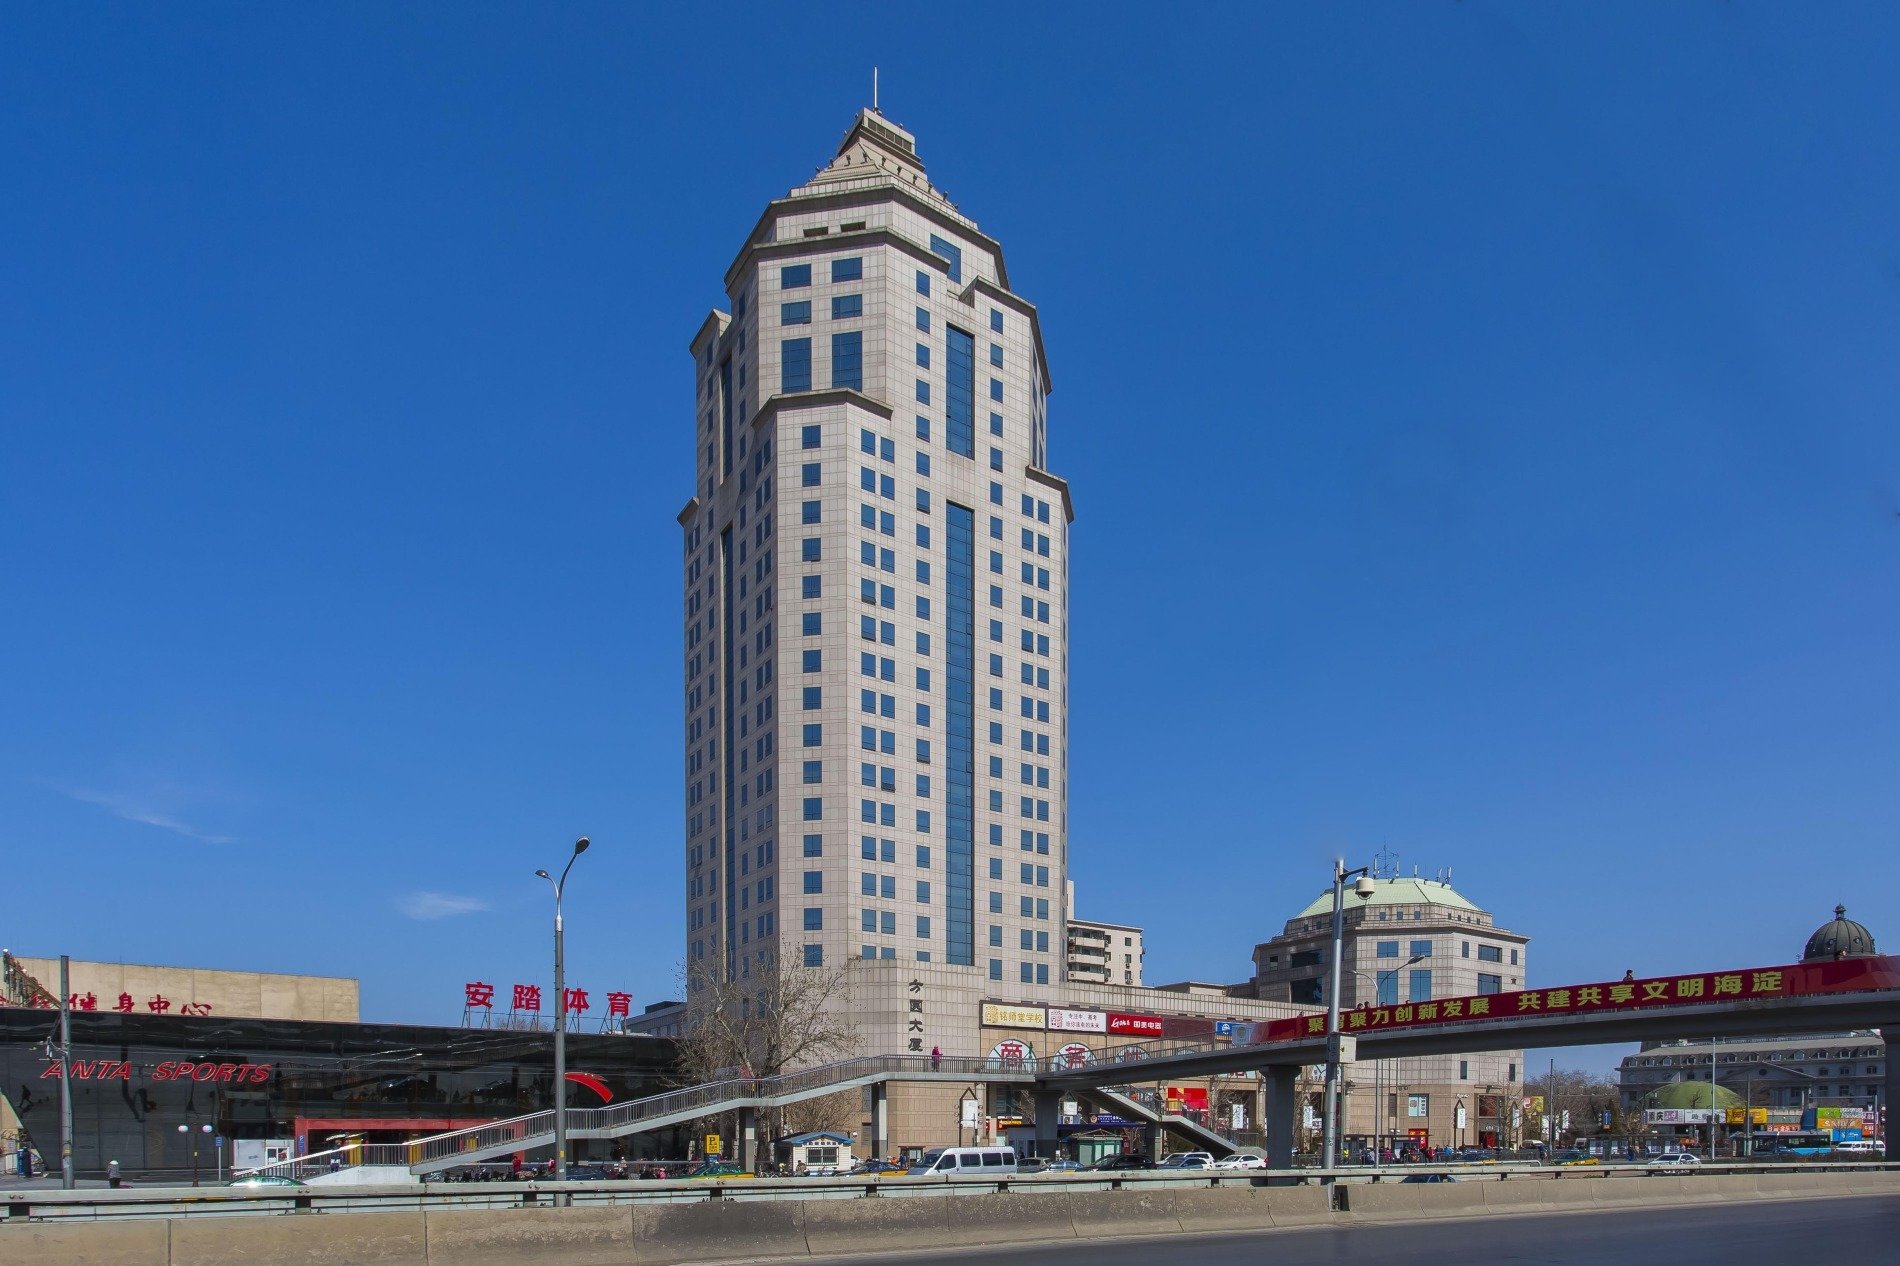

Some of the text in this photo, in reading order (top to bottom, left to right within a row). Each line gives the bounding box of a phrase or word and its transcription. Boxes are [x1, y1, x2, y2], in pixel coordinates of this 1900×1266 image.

[465, 981, 633, 1017] 安踏体育
[1518, 971, 1783, 1012] 共建共享文明海淀
[908, 979, 924, 1052] 方圆大厦
[1133, 1020, 1162, 1030] 国美电器
[40, 1059, 272, 1084] ANTA SPORTS
